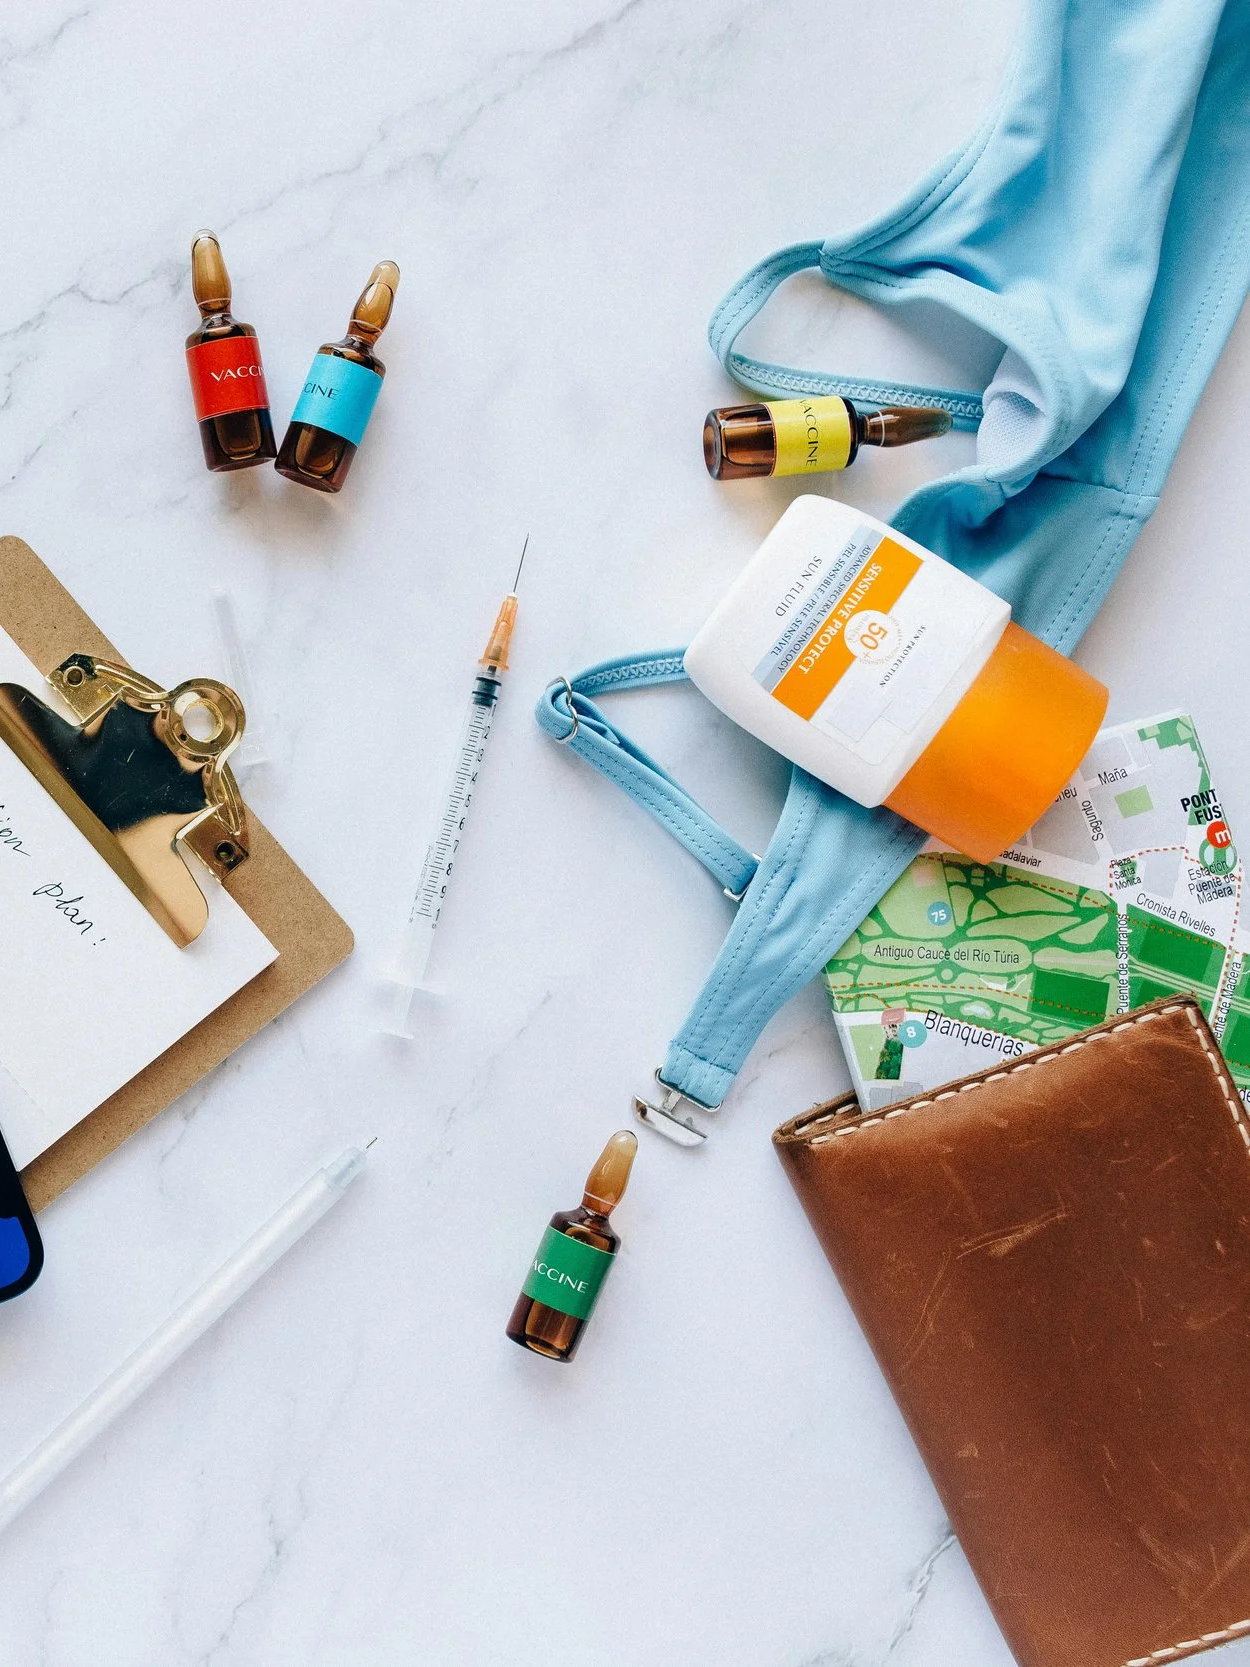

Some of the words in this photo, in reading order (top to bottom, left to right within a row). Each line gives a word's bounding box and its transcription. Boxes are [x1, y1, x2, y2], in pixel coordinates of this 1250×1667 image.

[839, 543, 856, 562] PIEL
[843, 545, 872, 581] ADVANCED
[802, 555, 822, 581] SUN
[818, 560, 846, 594] SENSIBLE
[775, 581, 804, 617] FLUID
[819, 581, 846, 617] SPECTRAL
[838, 563, 882, 620] SENSITIVE
[802, 598, 818, 618] PELE
[777, 617, 820, 673] TECHNOLOGY
[798, 620, 843, 674] PROTECT
[879, 640, 916, 687] PROTECTION
[1098, 767, 1128, 786] Maña
[1180, 788, 1218, 813] PONT
[1081, 800, 1104, 842] Sagunto
[1195, 804, 1222, 825] FUS
[999, 849, 1042, 868] adalaviar
[1110, 857, 1132, 868] Plaza
[1113, 867, 1135, 880] Santa
[1188, 877, 1223, 895] Puente
[1223, 872, 1236, 883] de
[1197, 885, 1234, 905] Madera
[931, 910, 947, 923] 75
[1136, 892, 1177, 920] Cronista
[1178, 910, 1216, 937] Rivelles
[1116, 913, 1129, 960] Serranos
[874, 944, 914, 961] Antiguo
[917, 946, 950, 960] Cauce
[953, 948, 969, 962] del
[1119, 963, 1129, 976] de
[1223, 961, 1241, 997] Madera
[1116, 978, 1129, 1015] Puente
[1220, 1001, 1231, 1014] de
[906, 1026, 917, 1038] 8
